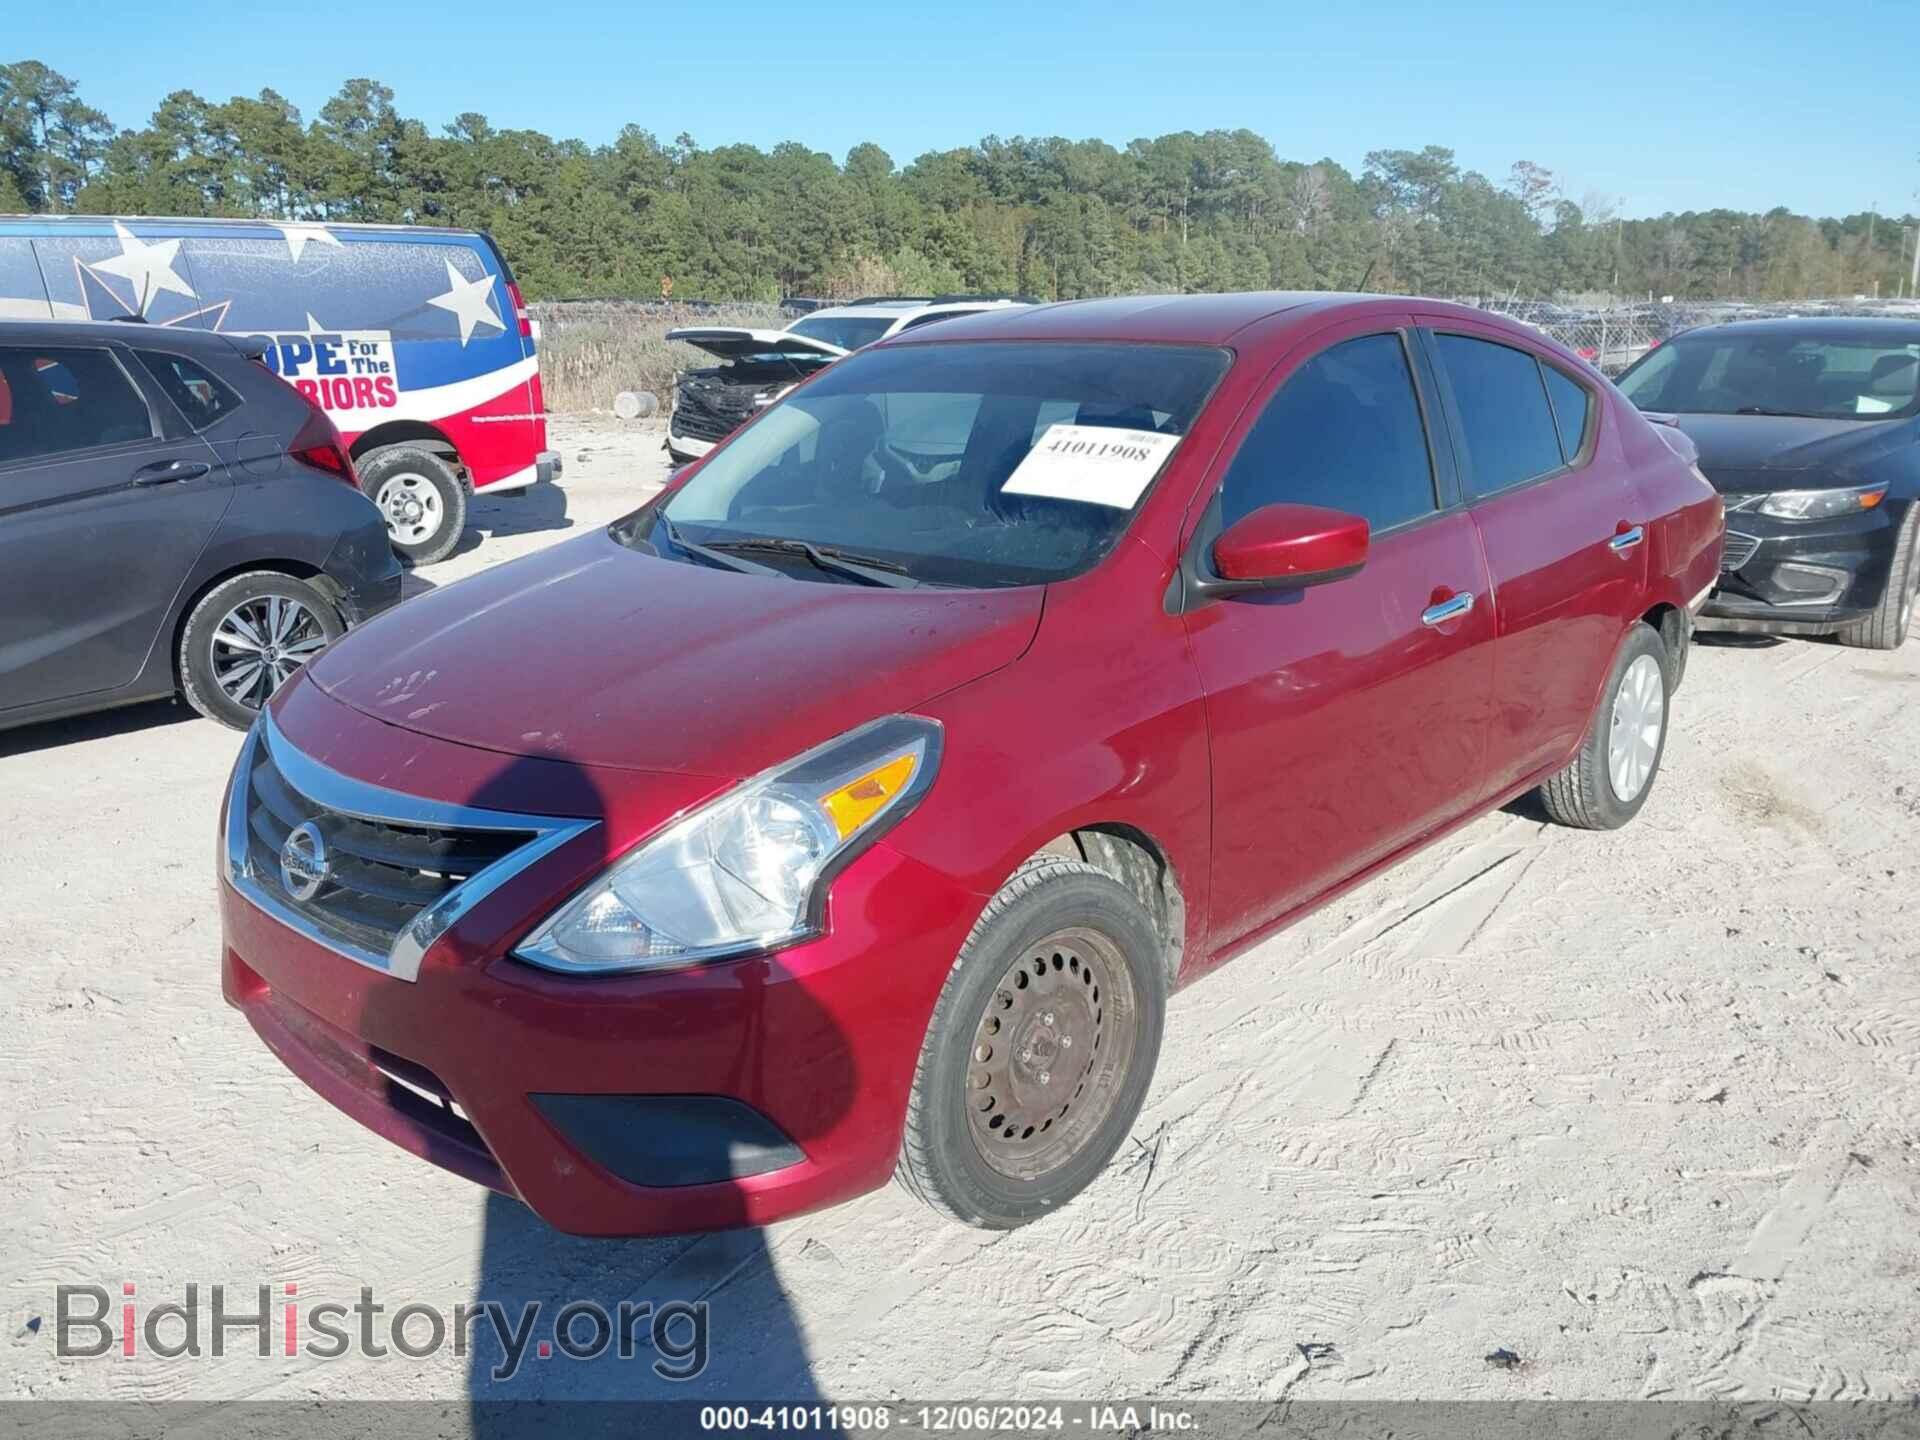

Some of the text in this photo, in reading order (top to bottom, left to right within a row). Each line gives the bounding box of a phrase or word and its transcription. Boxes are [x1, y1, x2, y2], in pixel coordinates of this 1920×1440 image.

[350, 340, 378, 355] For
[351, 358, 390, 373] The
[1048, 439, 1151, 461] 41011908
